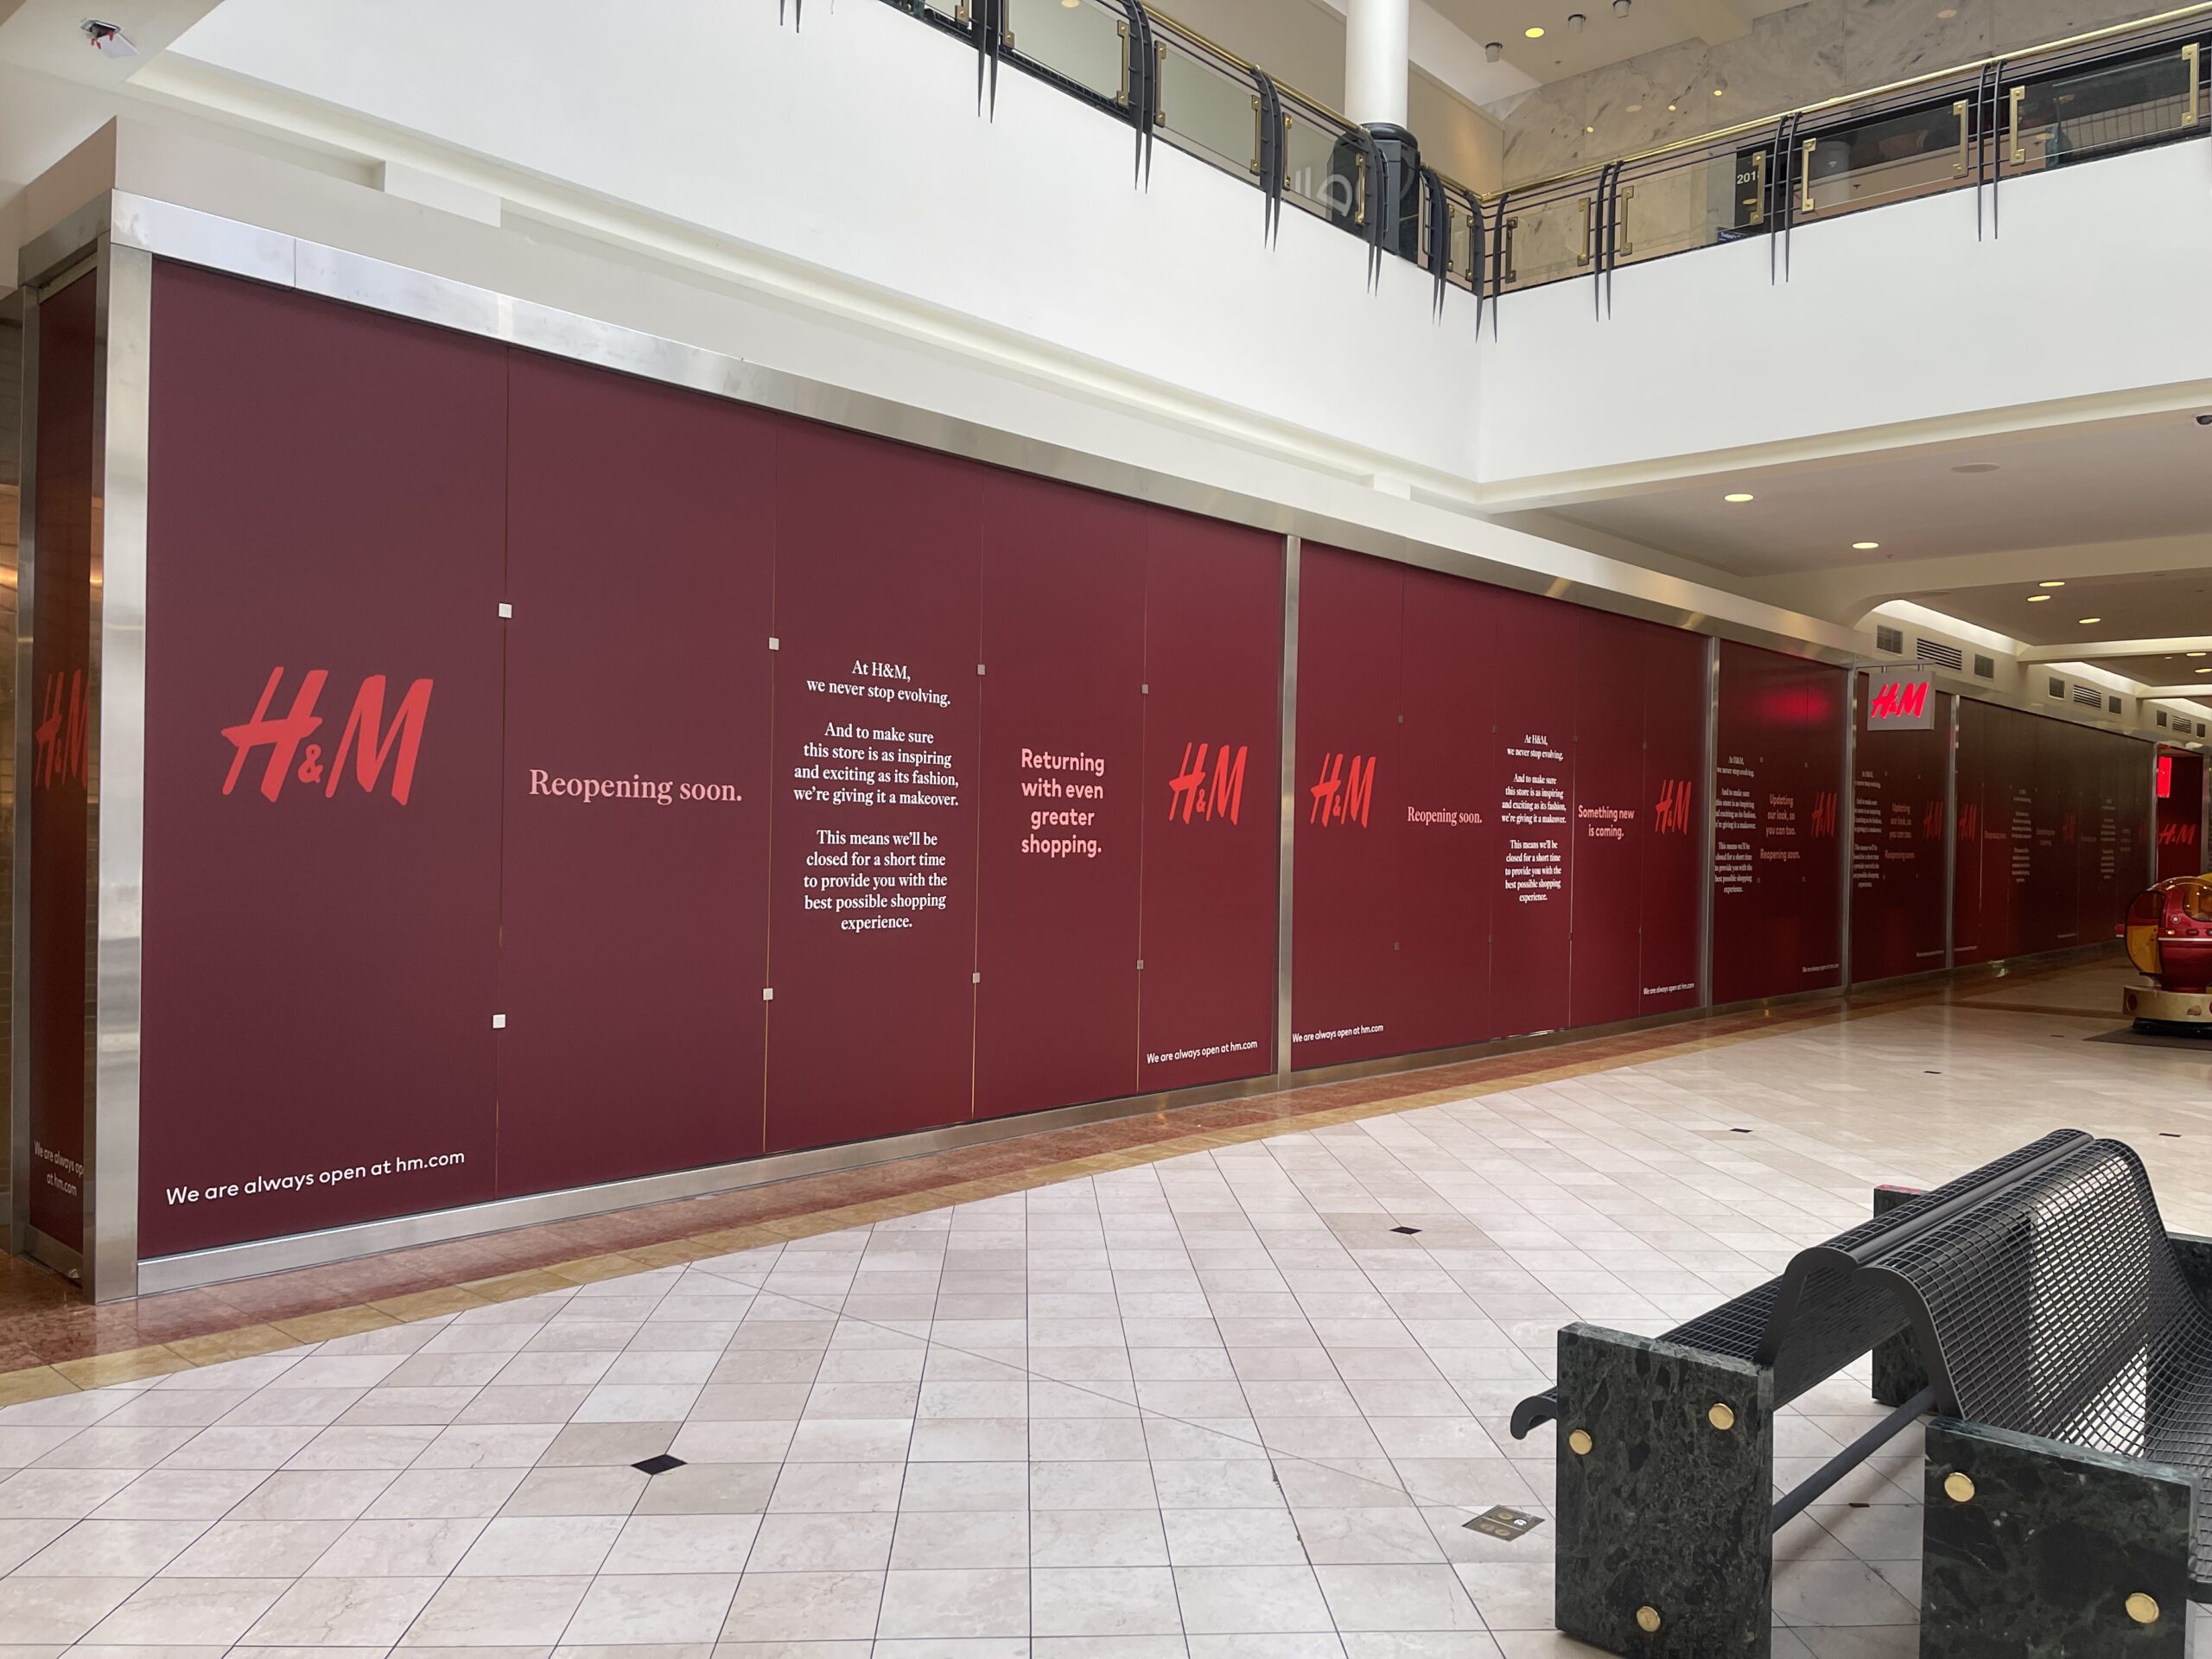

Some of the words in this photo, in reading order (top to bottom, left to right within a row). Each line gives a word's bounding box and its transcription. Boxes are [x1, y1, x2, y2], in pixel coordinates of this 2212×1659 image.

[1737, 171, 1759, 184] 201
[852, 660, 868, 675] At
[872, 662, 911, 682] H&M,
[807, 680, 825, 692] we
[830, 683, 865, 696] never
[868, 685, 895, 702] stop
[898, 689, 950, 708] evolving.
[1871, 682, 1929, 719] H&M
[35, 668, 88, 791] H&M
[221, 666, 434, 806] H&M
[824, 722, 853, 738] And
[856, 727, 869, 739] to
[873, 728, 905, 741] make
[908, 732, 934, 744] sure
[1524, 734, 1531, 744] At
[1532, 734, 1548, 747] H&M,
[804, 742, 829, 758] this
[832, 746, 865, 760] store
[868, 747, 878, 760] is
[881, 751, 894, 762] as
[898, 748, 951, 768] inspiring
[1021, 748, 1105, 777] Returning
[1516, 748, 1530, 757] never
[1530, 749, 1541, 760] stop
[1541, 749, 1564, 761] evolving.
[794, 765, 819, 779] and
[823, 766, 875, 785] exciting
[878, 772, 891, 783] as
[894, 769, 909, 784] its
[912, 770, 959, 788] fashion,
[1168, 741, 1248, 826] H&M
[1514, 773, 1525, 783] And
[1532, 774, 1546, 784] make
[529, 769, 674, 805] Reopening
[679, 783, 742, 802] soon.
[793, 786, 830, 801] we're
[833, 788, 874, 806] giving
[876, 789, 887, 803] it
[889, 792, 896, 804] a
[899, 791, 959, 806] makeover.
[1021, 778, 1061, 798] with
[1065, 784, 1103, 799] even
[1310, 753, 1376, 829] H&M
[1505, 785, 1516, 796] this
[1530, 787, 1535, 796] is
[1541, 787, 1564, 800] inspiring
[1502, 799, 1512, 809] and
[1512, 800, 1534, 811] exciting
[1548, 801, 1567, 812] fashion,
[1656, 779, 1692, 835] H&M
[1769, 794, 1794, 808] Updating
[1031, 808, 1095, 830] greater
[1408, 806, 1458, 827] Reopening
[1459, 812, 1482, 823] soon.
[1502, 812, 1516, 823] we're
[1516, 813, 1533, 825] giving
[1533, 813, 1538, 823] it
[1541, 814, 1567, 823] makeover.
[1578, 804, 1618, 823] Something
[1619, 810, 1635, 820] new
[817, 830, 846, 845] This
[849, 834, 890, 845] means
[893, 832, 920, 846] we'll
[924, 832, 938, 846] be
[1588, 823, 1594, 836] is
[1596, 824, 1624, 840] coming.
[1021, 833, 1103, 858] shopping.
[1510, 839, 1522, 849] This
[1540, 840, 1551, 849] we'll
[1551, 840, 1558, 849] be
[806, 851, 848, 866] closed
[851, 852, 871, 866] for
[874, 856, 880, 866] a
[884, 852, 916, 866] short
[919, 853, 946, 866] time
[1506, 853, 1522, 862] closed
[1536, 853, 1549, 862] short
[1549, 853, 1561, 861] time
[1760, 849, 1787, 861] Reopening
[1511, 866, 1531, 878] provide
[1531, 868, 1541, 877] you
[1541, 865, 1553, 874] with
[804, 875, 817, 887] to
[821, 873, 870, 891] provide
[873, 876, 895, 890] you
[899, 873, 925, 887] with
[929, 873, 948, 887] the
[1505, 880, 1516, 889] best
[1517, 879, 1538, 891] possible
[1538, 879, 1561, 889] shopping
[804, 895, 832, 910] best
[836, 893, 887, 912] possible
[891, 893, 946, 910] shopping
[1519, 892, 1548, 904] experience.
[841, 915, 912, 933] experience.
[1293, 1033, 1302, 1043] We
[1303, 1032, 1314, 1041] are
[1315, 1029, 1337, 1040] always
[1337, 1027, 1352, 1039] open
[1353, 1026, 1360, 1035] at
[1360, 1023, 1383, 1034] hm.com
[1147, 1052, 1160, 1064] We
[1160, 1052, 1173, 1062] are
[1174, 1048, 1201, 1060] always
[1201, 1046, 1219, 1058] open
[1221, 1044, 1230, 1053] at
[1230, 1039, 1258, 1052] hm.com
[35, 1141, 43, 1157] We
[44, 1149, 54, 1161] are
[54, 1150, 74, 1173] always
[75, 1163, 84, 1178] op
[47, 1173, 54, 1185] at
[54, 1173, 77, 1197] hm.com
[166, 1186, 200, 1205] We
[205, 1184, 239, 1200] are
[244, 1173, 315, 1192] always
[319, 1164, 366, 1186] open
[371, 1160, 391, 1176] at
[395, 1152, 465, 1173] hm.com
